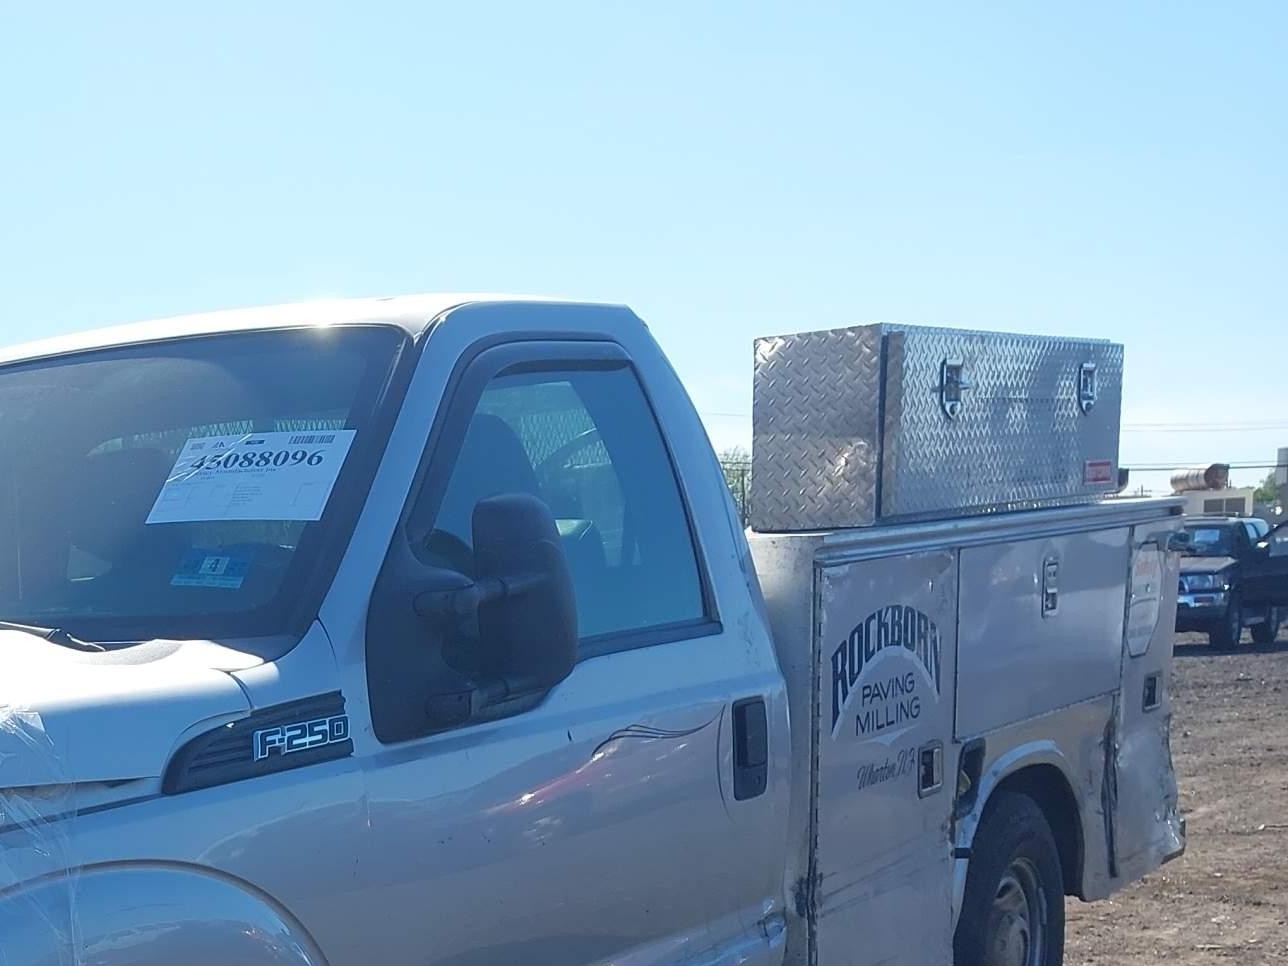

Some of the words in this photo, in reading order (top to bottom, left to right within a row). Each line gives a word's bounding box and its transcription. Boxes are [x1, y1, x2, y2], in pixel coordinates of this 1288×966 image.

[190, 449, 324, 471] 45088096
[831, 605, 942, 733] ROCKBORN
[862, 672, 915, 706] PAVING
[856, 697, 920, 736] MILLING
[253, 714, 351, 761] F-250
